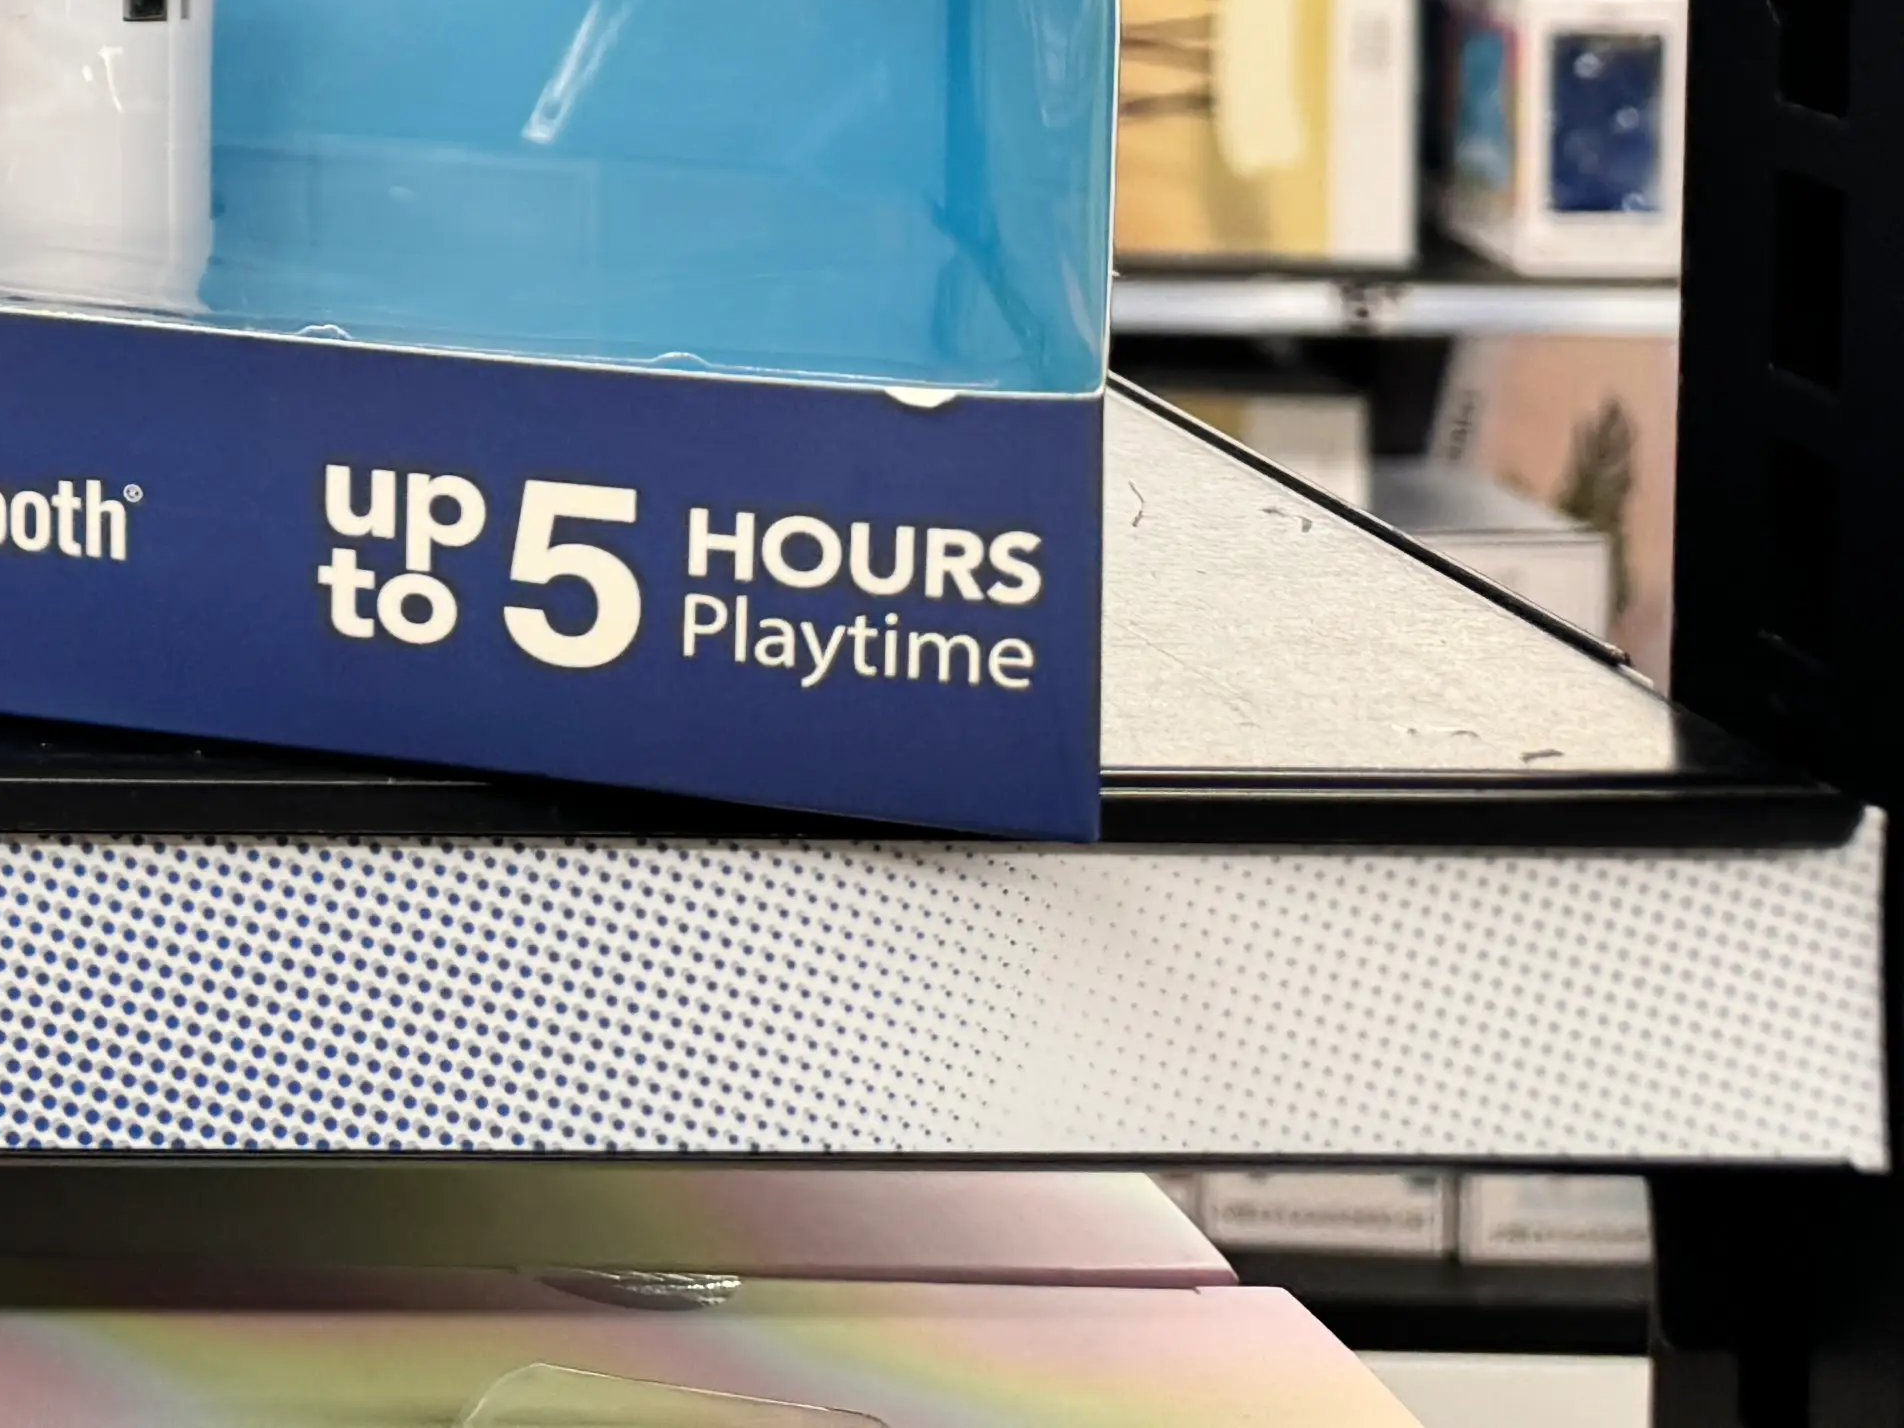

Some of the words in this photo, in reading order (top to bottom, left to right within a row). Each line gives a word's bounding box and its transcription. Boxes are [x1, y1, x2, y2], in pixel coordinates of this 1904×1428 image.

[324, 463, 486, 572] up
[687, 506, 1042, 607] HOURS
[318, 548, 458, 644] to
[502, 483, 640, 668] 5
[682, 594, 1036, 690] Playtime
